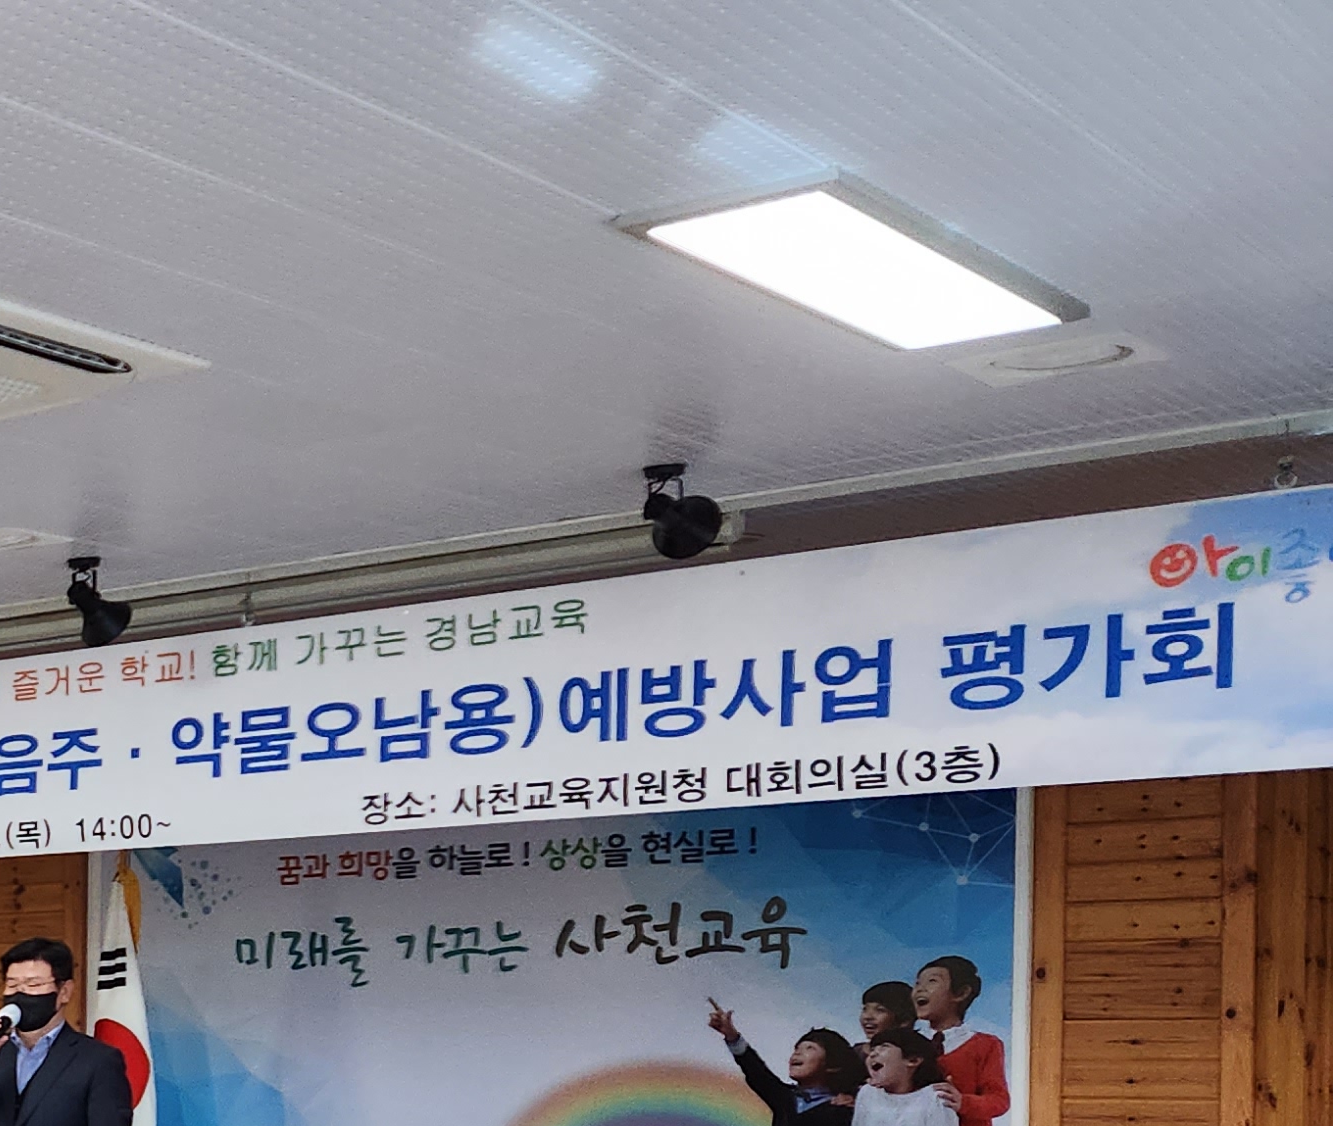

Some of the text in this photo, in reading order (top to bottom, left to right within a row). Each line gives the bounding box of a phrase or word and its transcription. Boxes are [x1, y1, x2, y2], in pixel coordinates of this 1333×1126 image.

[12, 661, 106, 702] 즐거운
[120, 649, 196, 687] 학교!
[211, 638, 278, 678] 함께
[295, 625, 408, 665] 가꾸는
[424, 598, 588, 653] 경남교육
[939, 601, 1236, 711] 평가회
[75, 813, 172, 843] 14:00~
[360, 742, 1002, 827] 장소: 사천교육지원청 대회의실(3층)
[276, 853, 331, 886] 꿈과
[336, 846, 421, 881] 희망을
[539, 833, 632, 874] 상상을
[235, 895, 808, 987] 미래를 가꾸는 사천교육
